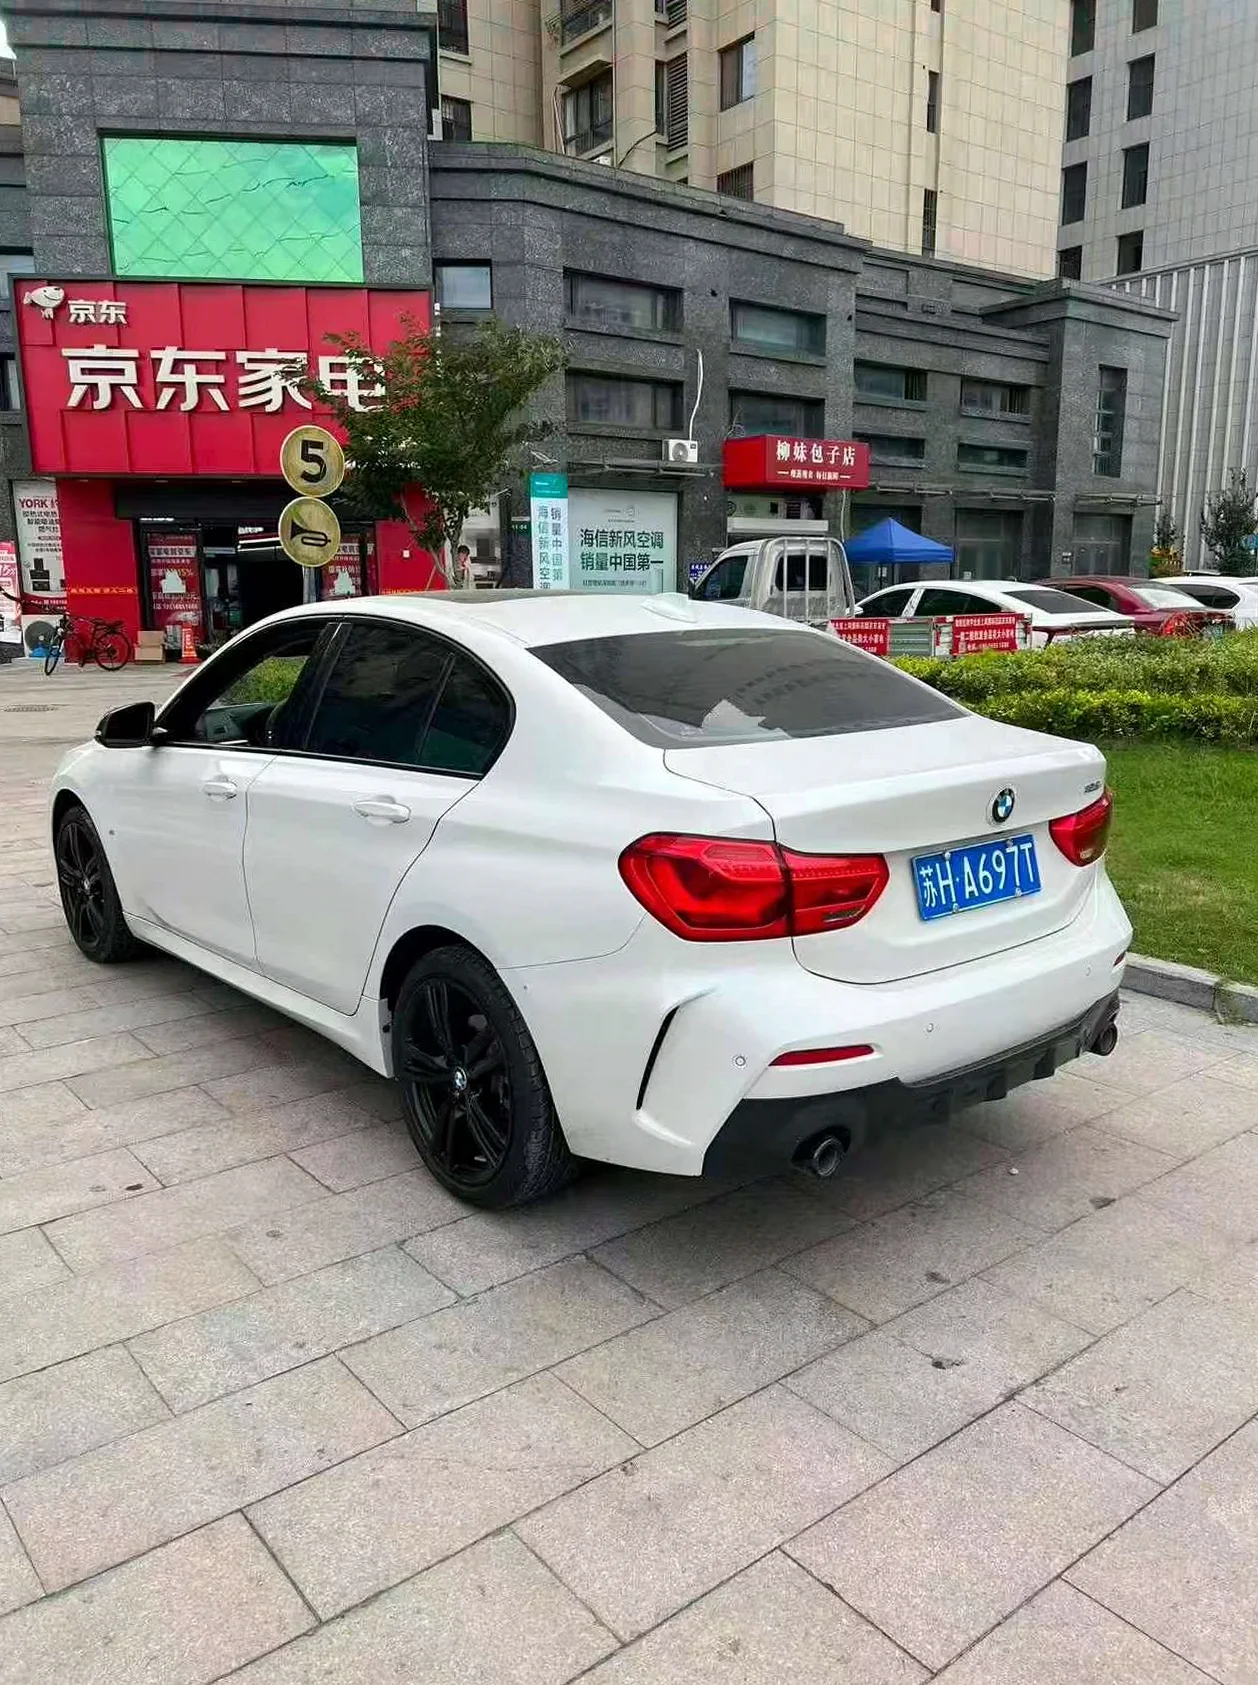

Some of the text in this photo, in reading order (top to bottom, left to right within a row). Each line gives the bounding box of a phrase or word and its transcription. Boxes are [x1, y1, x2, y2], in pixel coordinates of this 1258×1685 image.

[68, 299, 127, 324] 京东
[61, 344, 388, 413] 京东家电
[299, 439, 327, 484] 5
[776, 440, 856, 467] 柳妹包子店
[19, 498, 48, 509] YORK
[580, 528, 664, 549] 海信新风空调
[580, 551, 664, 572] 销量中国第一
